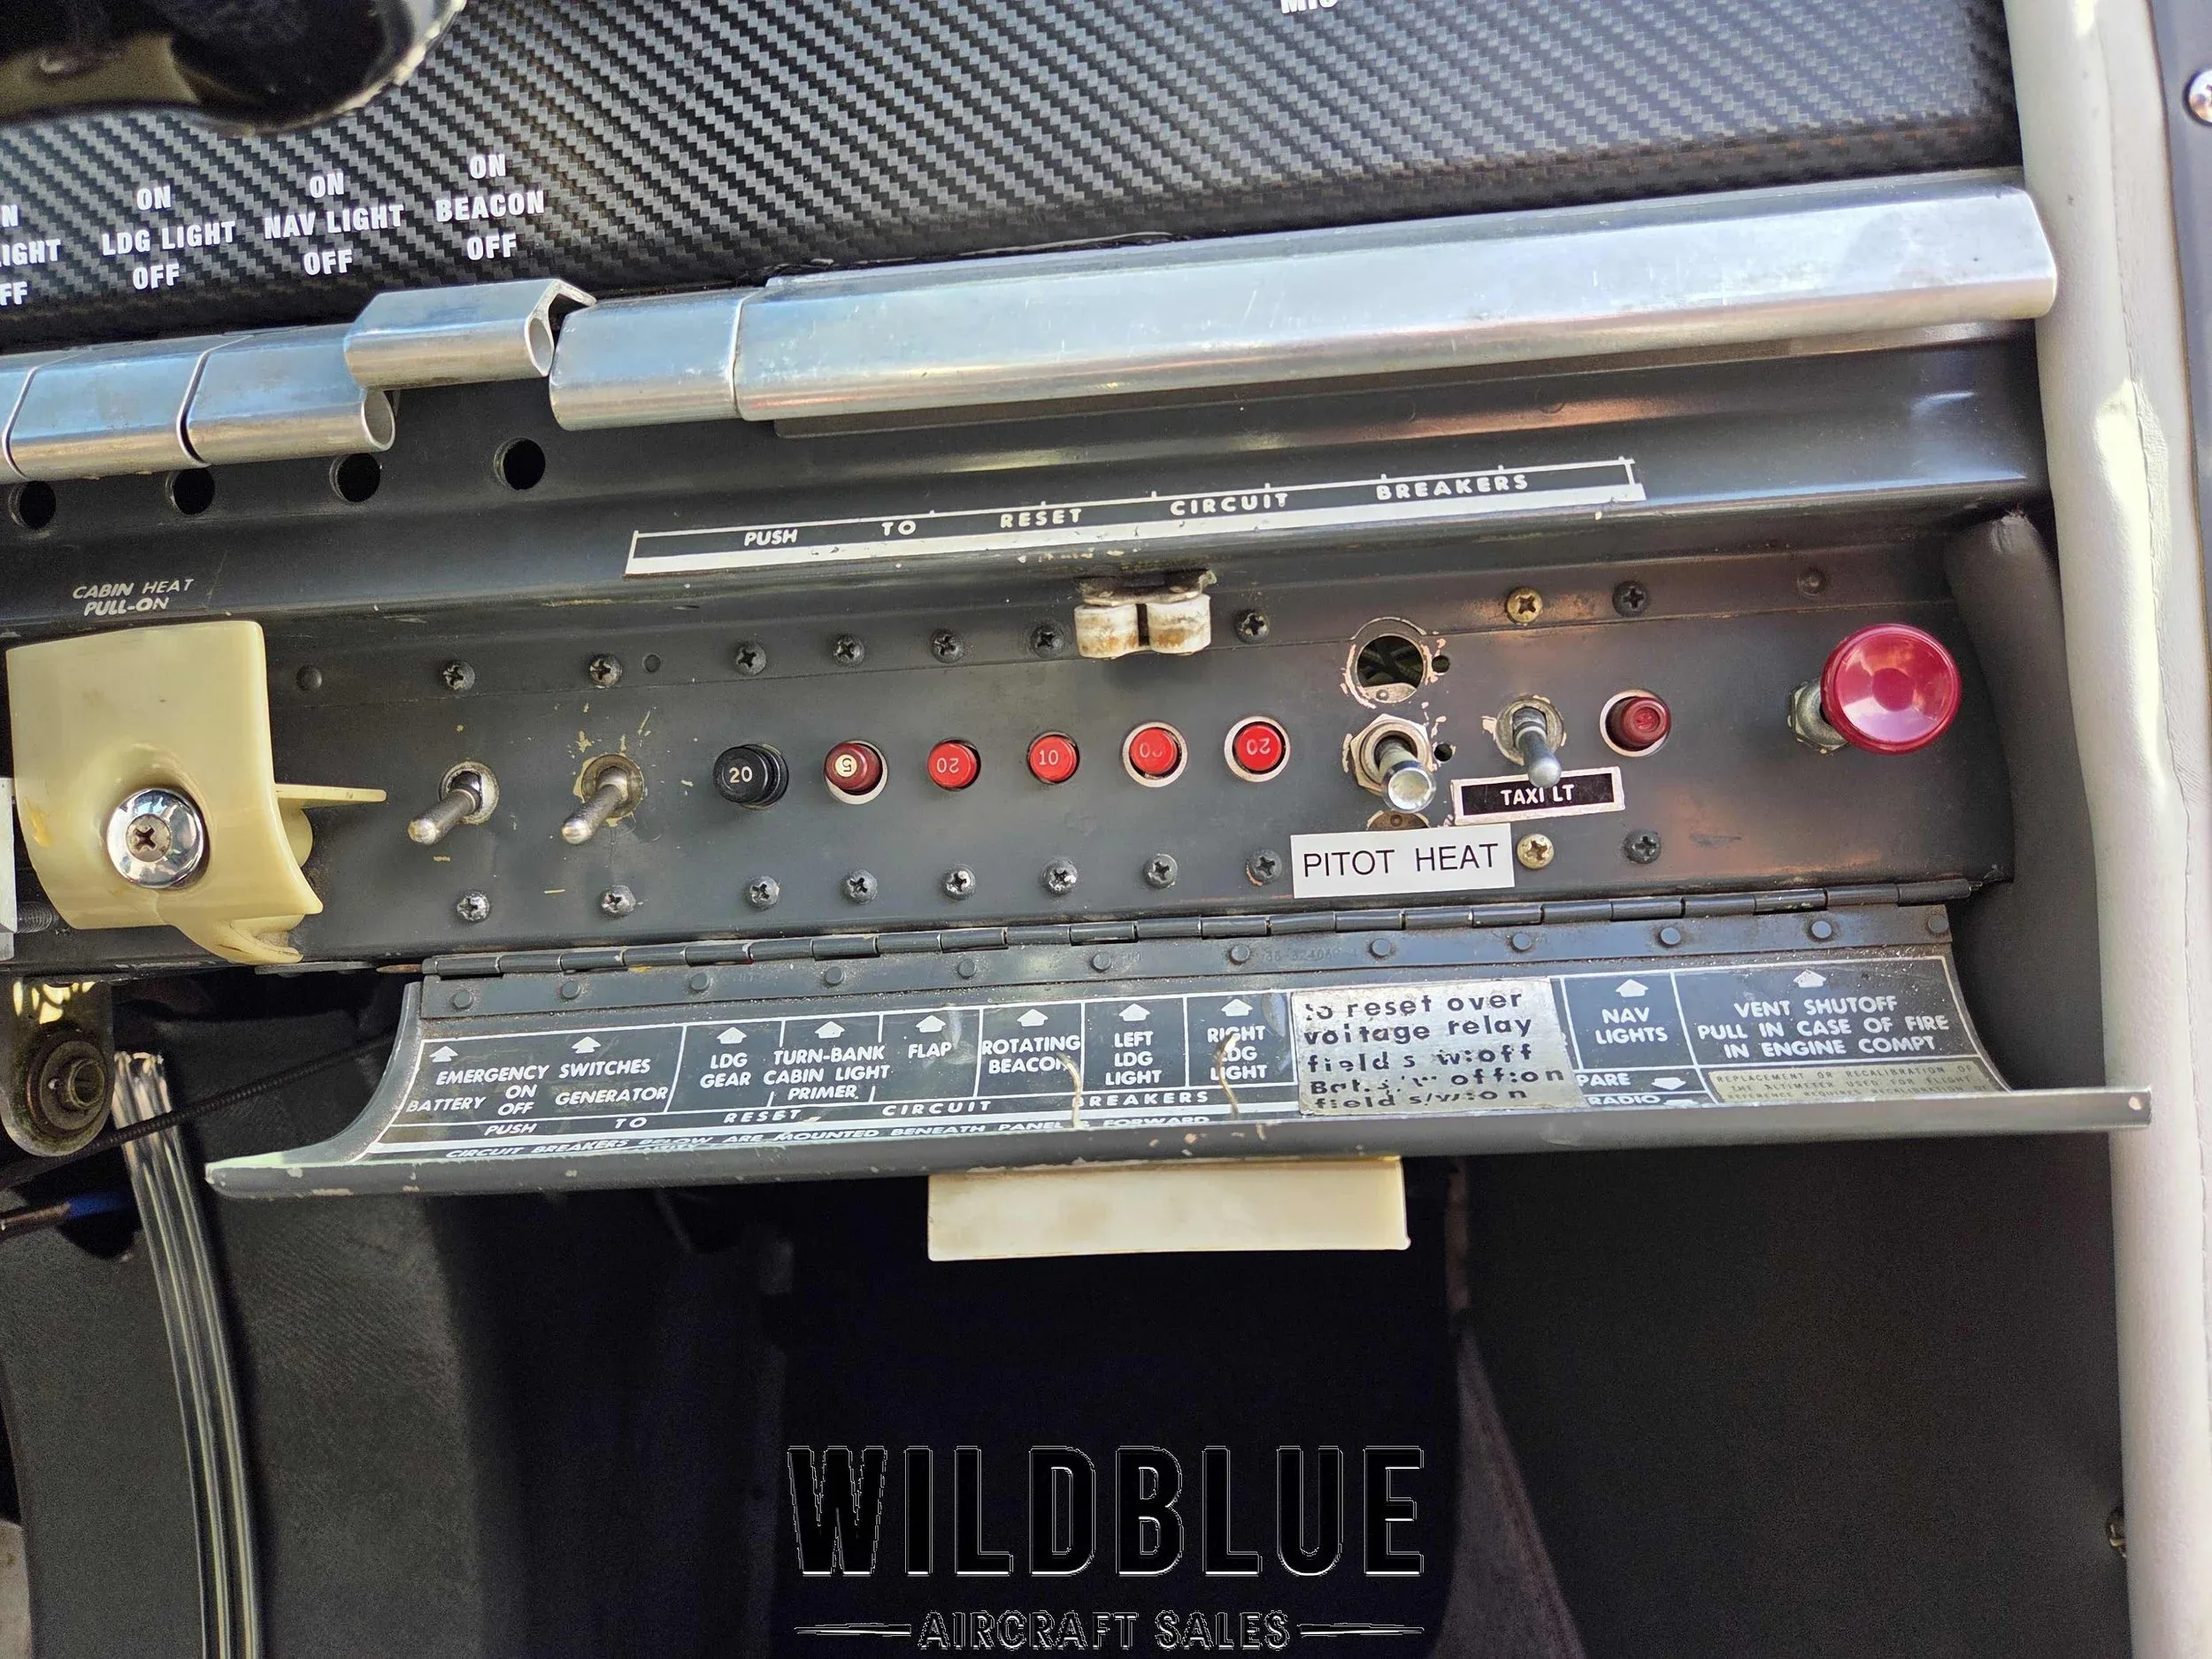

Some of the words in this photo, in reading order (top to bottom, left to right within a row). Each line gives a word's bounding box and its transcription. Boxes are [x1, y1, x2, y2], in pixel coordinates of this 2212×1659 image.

[469, 152, 507, 180] ON
[309, 171, 345, 199] ON
[136, 184, 172, 211] ON
[435, 189, 546, 223] BEACON
[0, 204, 19, 228] N
[264, 211, 315, 240] NAV
[326, 203, 405, 234] LIGHT
[101, 231, 150, 257] LDG
[162, 219, 236, 251] LIGHT
[466, 232, 518, 260] OFF
[0, 238, 61, 266] IGHT
[303, 249, 353, 276] OFF
[132, 264, 180, 291] OFF
[0, 280, 28, 306] FF
[743, 528, 798, 547] PUSH
[881, 519, 917, 536] TO
[1000, 508, 1082, 529] RESET
[1169, 491, 1289, 517] CIRCUIT
[1375, 473, 1529, 501] BREAKERS
[73, 582, 134, 600] CABIN
[142, 578, 194, 595] HEAT
[84, 596, 169, 617] PULL-ON
[1039, 749, 1059, 766] 10
[1246, 737, 1271, 756] 20
[728, 765, 753, 784] 20
[841, 757, 853, 773] 5
[936, 757, 960, 774] 20
[1500, 787, 1545, 807] TAXI
[1553, 784, 1576, 803] LT
[1303, 848, 1396, 879] PITOT
[1416, 841, 1500, 873] HEAT
[1348, 995, 1432, 1018] reset
[1447, 992, 1523, 1012] over
[1601, 1007, 1650, 1025] NAV
[1733, 1000, 1791, 1018] VENT
[1803, 995, 1898, 1016] SHUTOFF
[1448, 1015, 1532, 1037] relay
[1594, 1026, 1668, 1045] LIGHTS
[1697, 1023, 1748, 1041] PULL
[1758, 1021, 1785, 1039] IN
[1796, 1018, 1852, 1037] CASE
[1863, 1017, 1893, 1033] OF
[1904, 1015, 1950, 1032] FIRE
[981, 1034, 1081, 1056] ROTATING
[1114, 1030, 1154, 1048] LEFT
[1724, 1043, 1750, 1059] IN
[1761, 1040, 1847, 1058] ENGINE
[710, 1052, 748, 1070] LDG
[773, 1045, 885, 1065] TURN-BANK
[907, 1041, 953, 1060] FLAP
[1114, 1050, 1154, 1068] LDG
[1308, 1050, 1390, 1072] field
[435, 1064, 550, 1086] EMERGENCY
[558, 1058, 651, 1079] SWITCHES
[700, 1071, 752, 1088] GEAR
[763, 1067, 825, 1086] CABIN
[835, 1064, 890, 1081] LIGHT
[1105, 1068, 1163, 1087] LIGHT
[1210, 1064, 1268, 1081] LIGHT
[1575, 1072, 1632, 1087] PARE
[1716, 1071, 1806, 1084] REPLACEMENT
[1816, 1071, 1833, 1079] OR
[1846, 1065, 1946, 1079] RECALIBRATION
[1957, 1064, 1973, 1073] OF
[504, 1085, 538, 1100] ON
[1763, 1081, 1834, 1092] ALTIMETER
[1926, 1075, 1972, 1086] FLIGHT
[406, 1095, 487, 1113] BATTERY
[555, 1087, 669, 1106] GENERATOR
[1587, 1094, 1661, 1105] RADIO
[484, 1123, 538, 1136] PUSH
[614, 1117, 648, 1129] TO
[723, 1109, 802, 1124] RESET
[881, 1100, 991, 1117] CIRCUIT
[1071, 1091, 1209, 1109] BREAKERS
[497, 1102, 535, 1117] OFF
[445, 1147, 525, 1158] CIRCUIT
[531, 1139, 630, 1155] BREAKERS
[722, 1133, 764, 1144] ARE
[773, 1128, 879, 1141] MOUNTED
[890, 1124, 986, 1136] BENEATH
[998, 1120, 1064, 1132] PANEL
[1103, 1116, 1210, 1127] FORWARD
